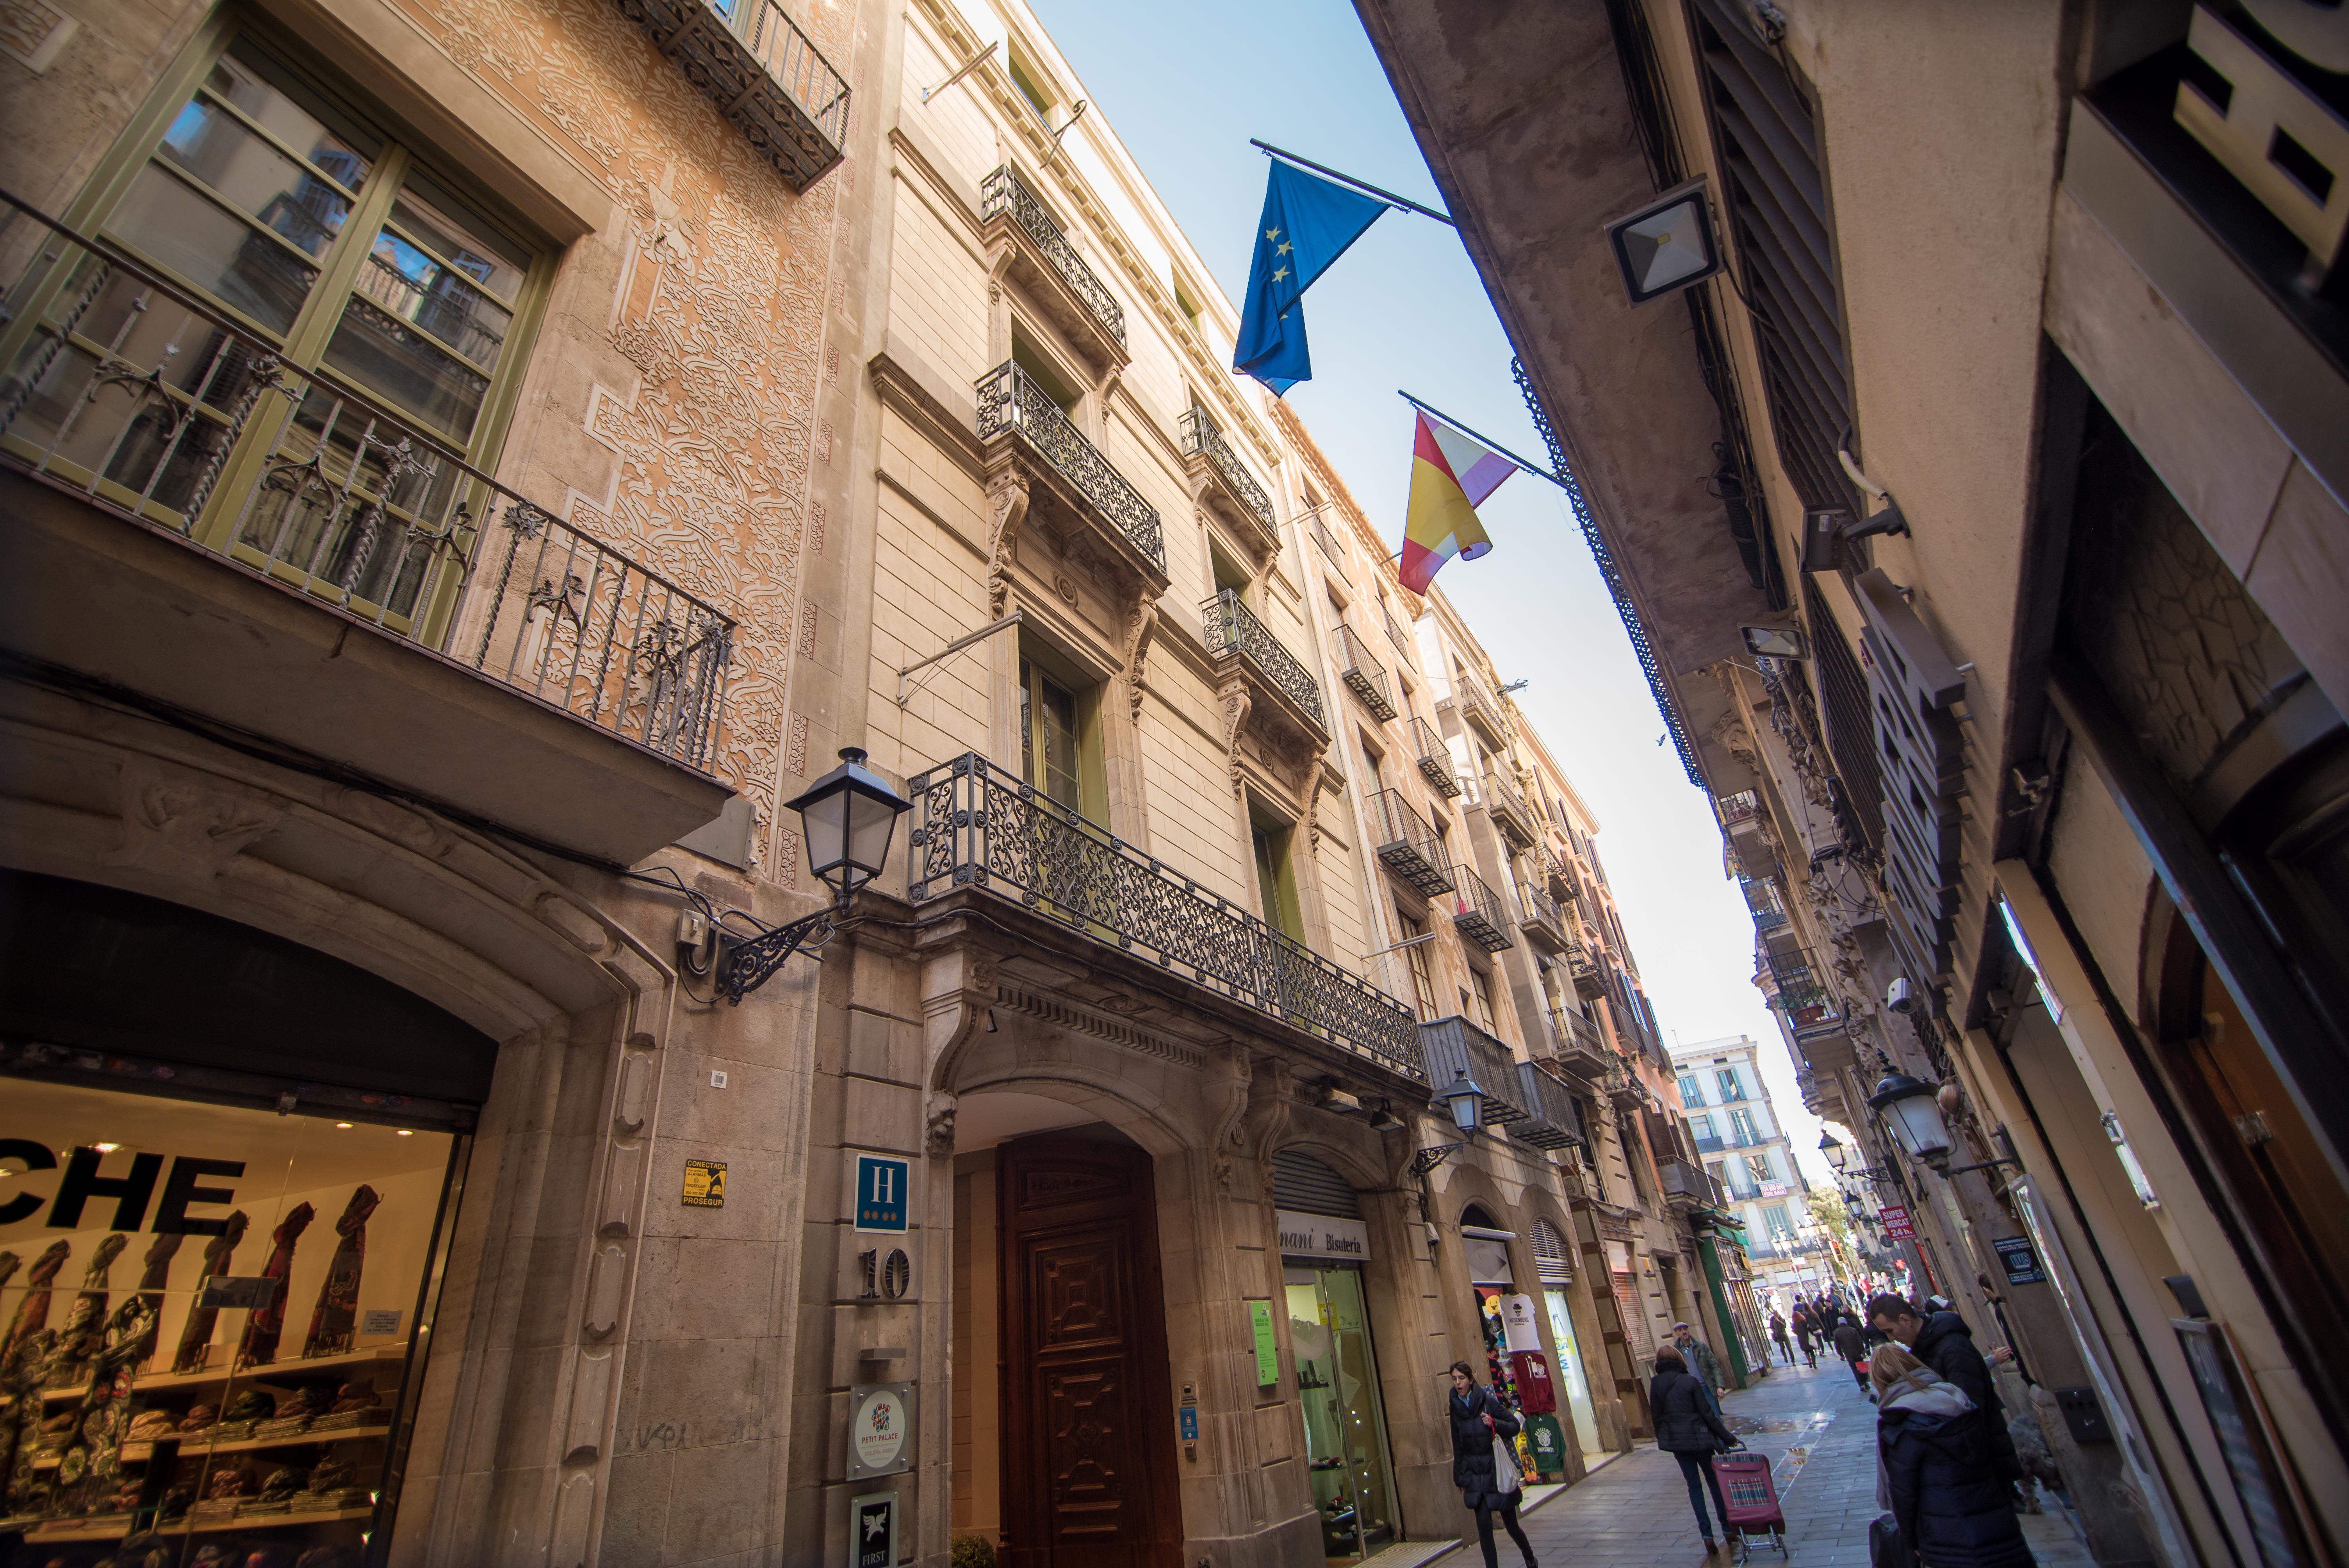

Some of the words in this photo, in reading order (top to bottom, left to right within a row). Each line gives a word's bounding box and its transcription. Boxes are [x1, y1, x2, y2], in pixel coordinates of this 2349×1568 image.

[1855, 568, 1952, 975] BOQUERIA
[687, 1160, 726, 1170] CONECTADA
[872, 1166, 896, 1204] H
[683, 1197, 723, 1206] PROSEGUR
[1882, 1209, 1905, 1220] SUPER
[1885, 1218, 1909, 1228] MERCAT
[1891, 1228, 1903, 1237] 24
[1326, 1234, 1361, 1253] Bisutería
[859, 1247, 910, 1299] 10
[862, 1435, 877, 1443] PETIT
[862, 1550, 886, 1566] FIRST
